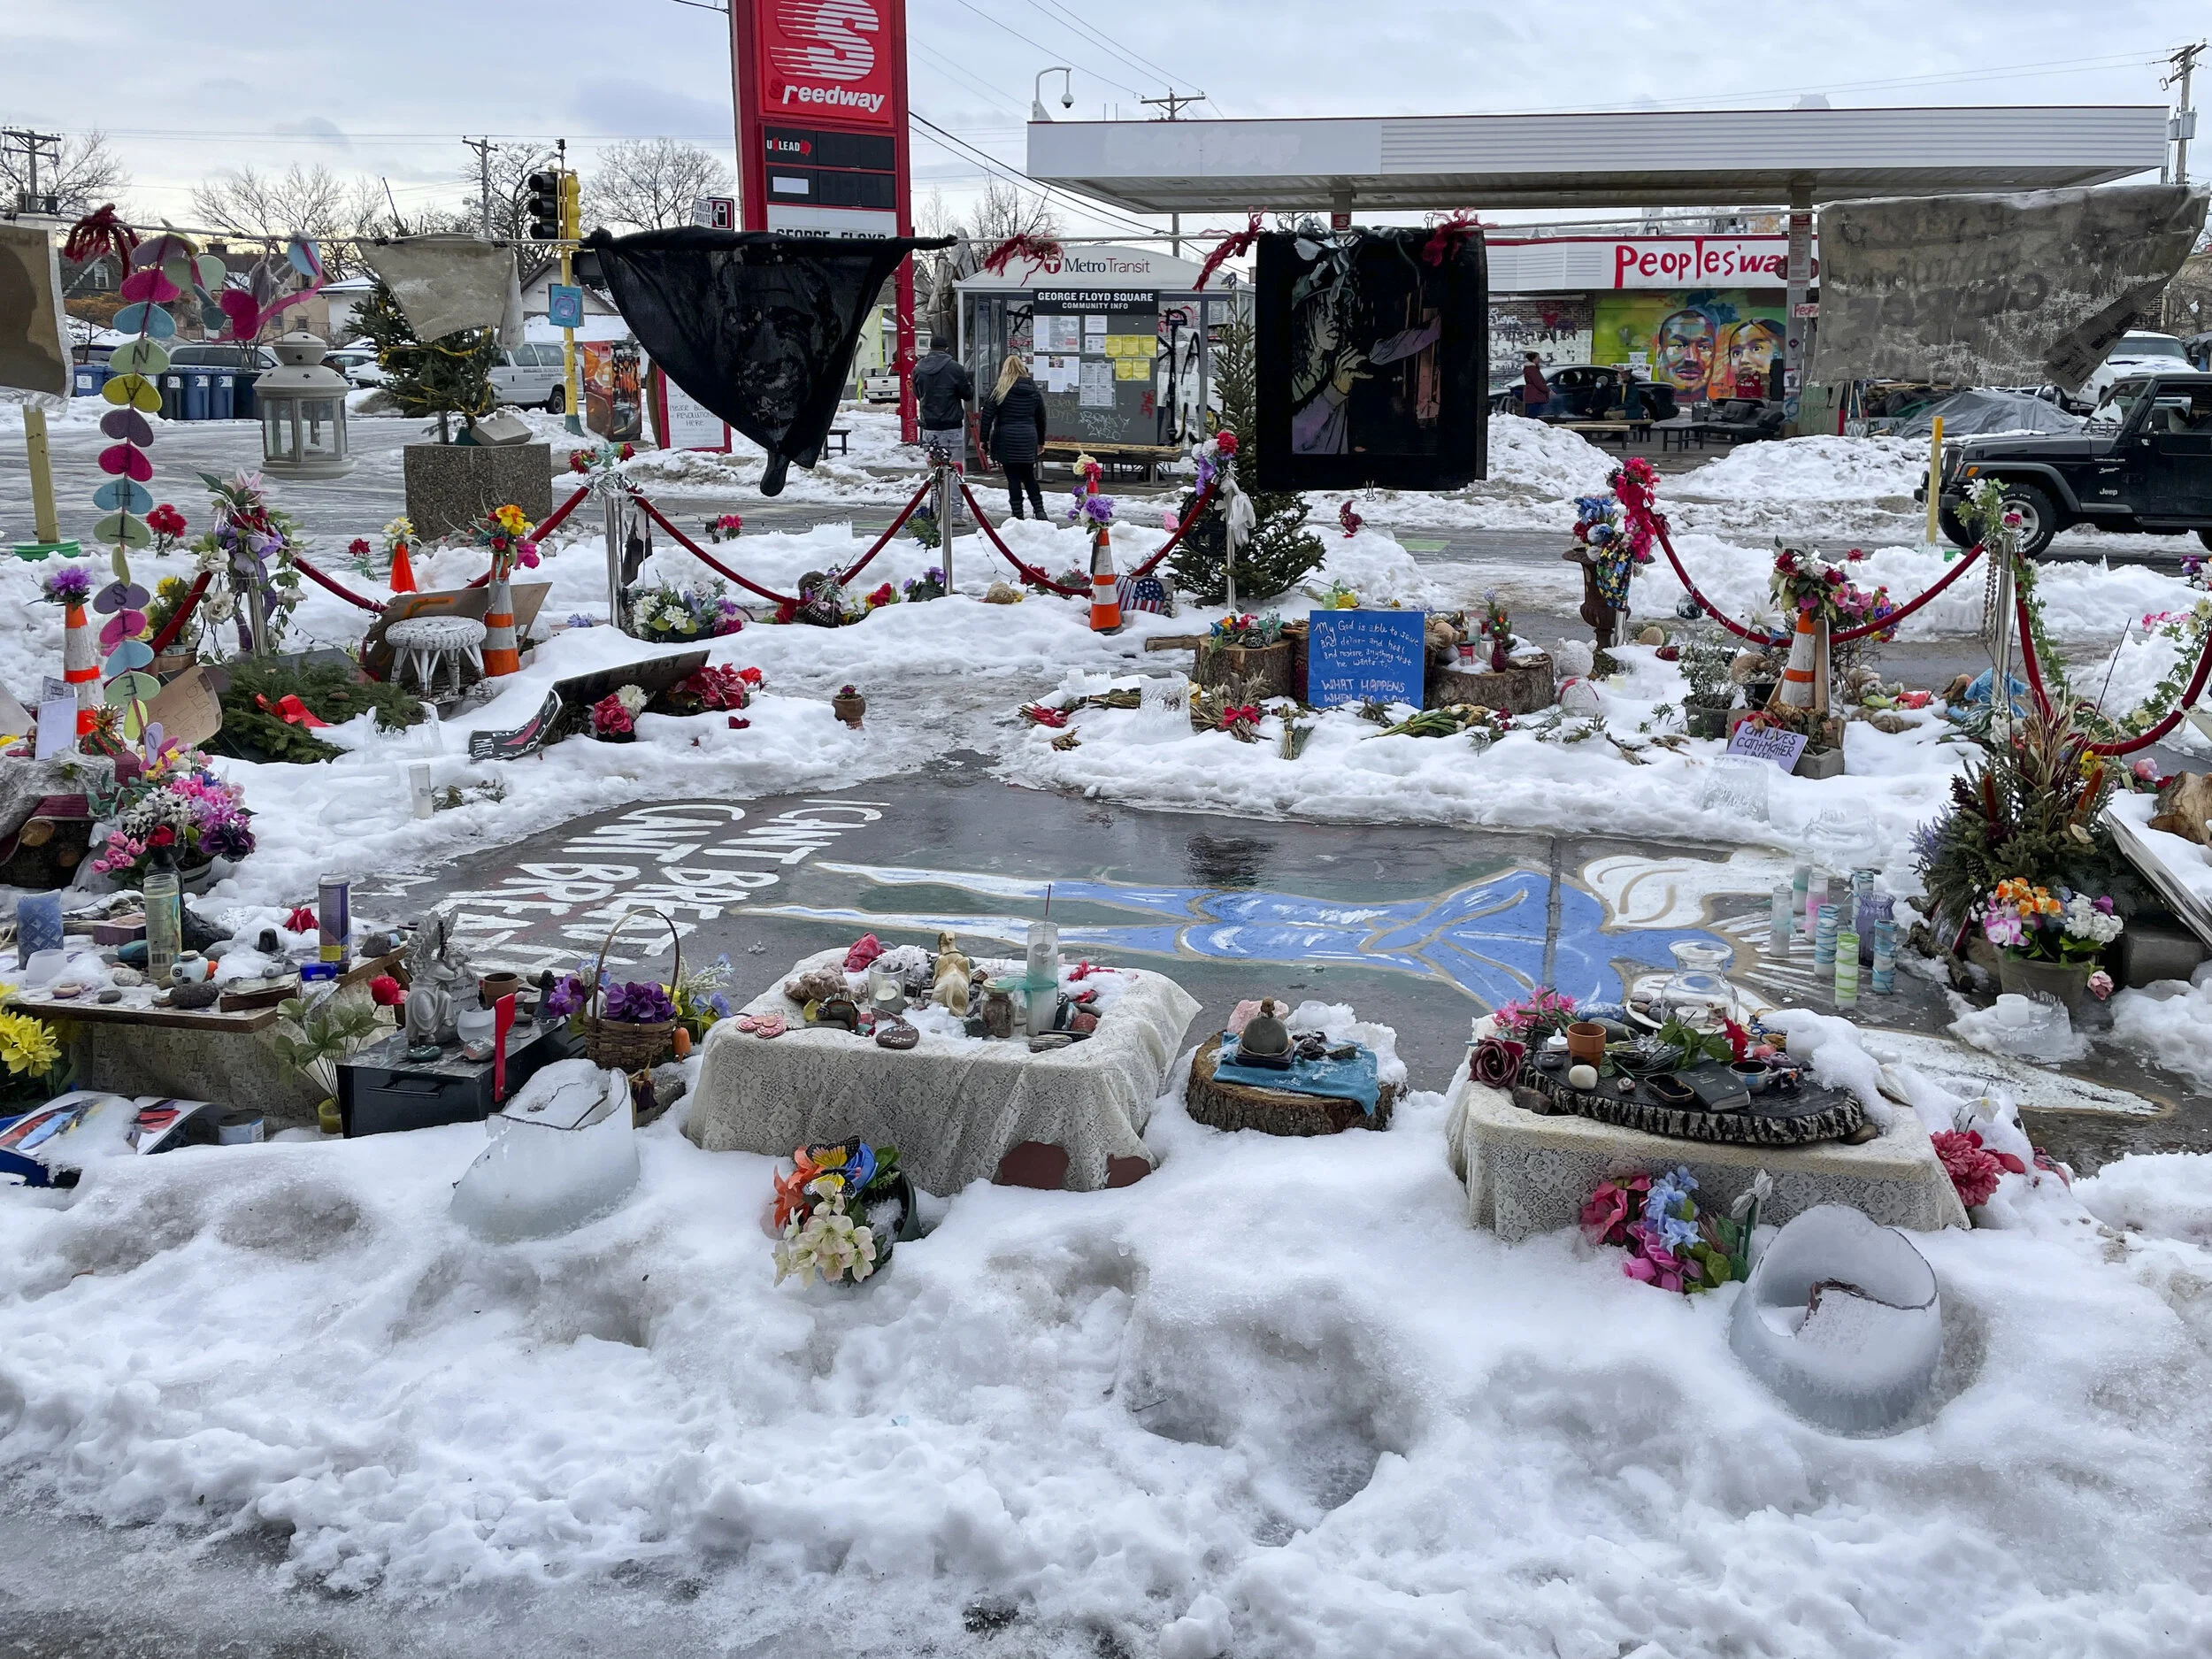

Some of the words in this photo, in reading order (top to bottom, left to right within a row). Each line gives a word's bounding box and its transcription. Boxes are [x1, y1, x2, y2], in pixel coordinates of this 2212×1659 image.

[766, 139, 811, 155] ULEAD
[696, 212, 710, 224] ROUTE
[1038, 292, 1077, 302] GEORGE
[1079, 292, 1111, 302] FLOYD
[1113, 292, 1154, 303] SQUARE
[2099, 488, 2118, 496] Jeep
[1314, 620, 1336, 639] My
[1338, 620, 1354, 632] God
[1358, 622, 1365, 632] is
[1390, 626, 1398, 637] to
[1400, 631, 1420, 647] save
[1320, 636, 1337, 649] and
[1369, 637, 1383, 648] and
[1387, 638, 1406, 654] heal
[1324, 649, 1337, 660] and
[1339, 649, 1363, 658] restore
[1365, 649, 1394, 663] anything
[1395, 655, 1412, 666] that
[1352, 657, 1376, 666] wants
[1321, 679, 1354, 691] WHAT
[1361, 679, 1405, 693] HAPPENS
[1324, 694, 1352, 704] WHEN
